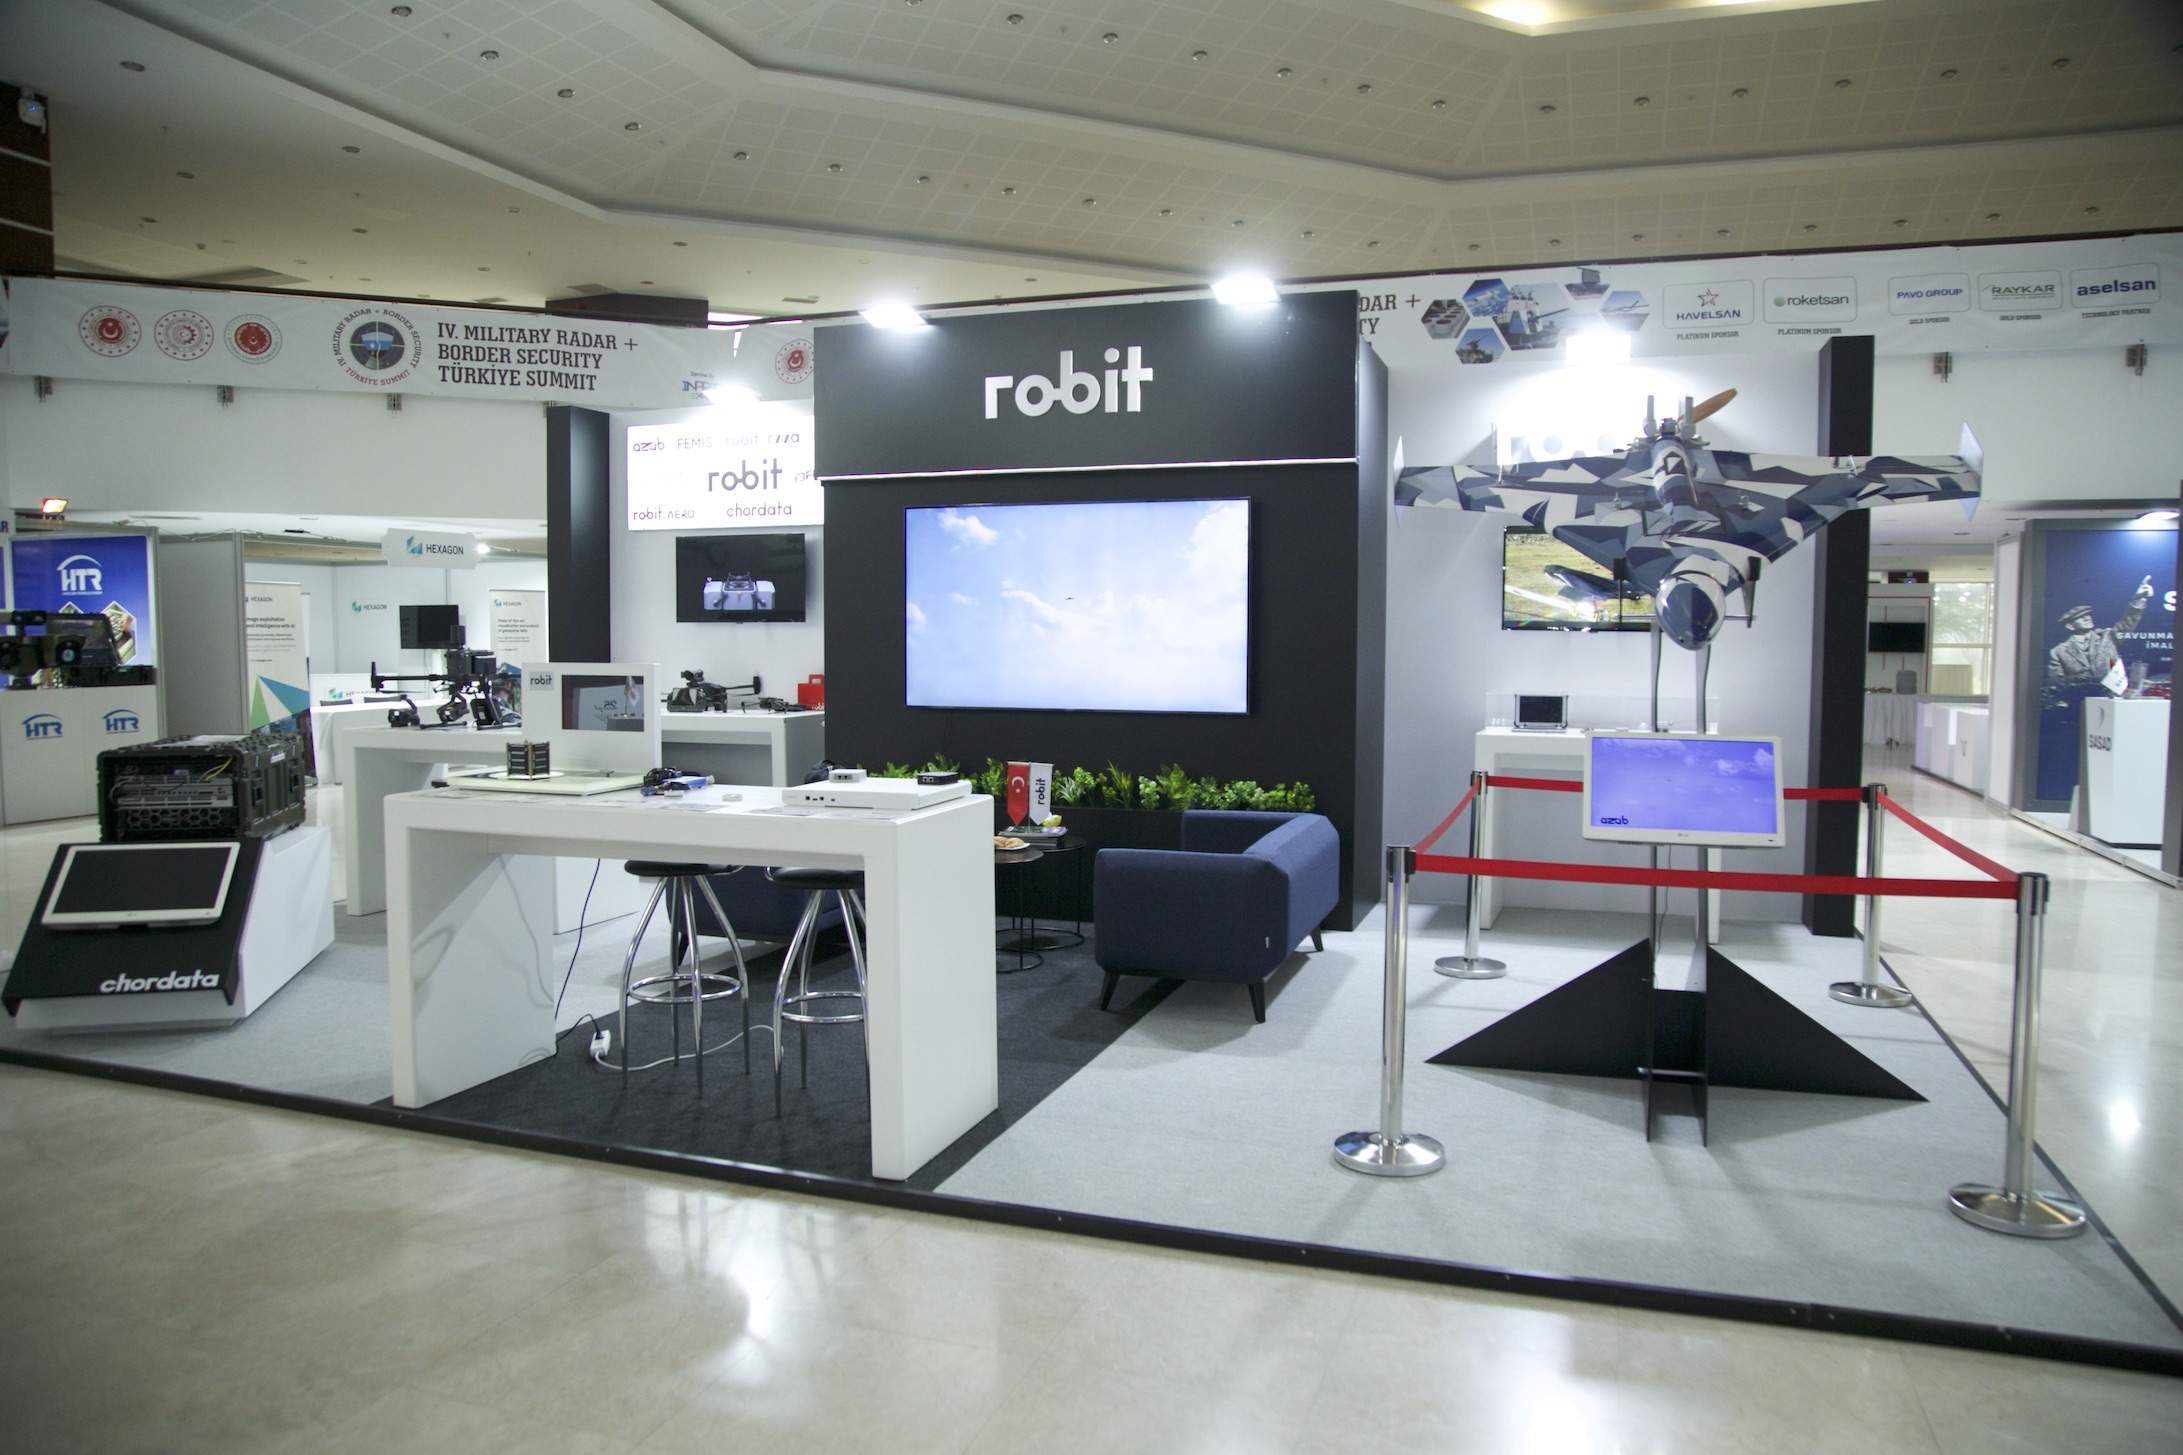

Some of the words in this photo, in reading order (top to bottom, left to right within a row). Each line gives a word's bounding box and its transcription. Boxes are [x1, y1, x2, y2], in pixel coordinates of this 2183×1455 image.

[1896, 290, 1924, 299] PAVO
[1925, 288, 1963, 298] GROUP
[1992, 284, 2056, 294] RAYKAR
[2077, 279, 2156, 296] aselsan
[1787, 294, 1849, 306] roketsan
[1676, 309, 1741, 321] HAVELSAN
[332, 321, 346, 356] MILITARY
[344, 308, 372, 323] RADAR
[382, 308, 414, 331] BORDER
[410, 330, 422, 368] SECURITY
[438, 322, 458, 340] IV.
[464, 325, 552, 344] MILITARY
[556, 330, 618, 350] RADAR
[624, 338, 639, 351] +
[1676, 332, 1710, 340] PLATINUM
[1778, 328, 1812, 336] PLATINUM
[438, 344, 512, 364] BORDER
[516, 348, 603, 370] SECURITY
[380, 368, 411, 386] SUMMIT
[438, 362, 521, 386] TÜRKİYE
[526, 370, 597, 391] SUMMIT
[985, 345, 1154, 420] robit
[708, 458, 783, 492] robit
[726, 502, 792, 517] chordata
[426, 544, 464, 555] HEXAGON
[61, 568, 103, 591] HTR
[2116, 632, 2174, 640] SAVUNMA
[530, 674, 552, 685] robit
[26, 722, 63, 737] HTR
[106, 716, 139, 731] HTR
[2088, 734, 2112, 752] SASAD
[1035, 778, 1046, 805] robit
[100, 969, 220, 993] chordata
